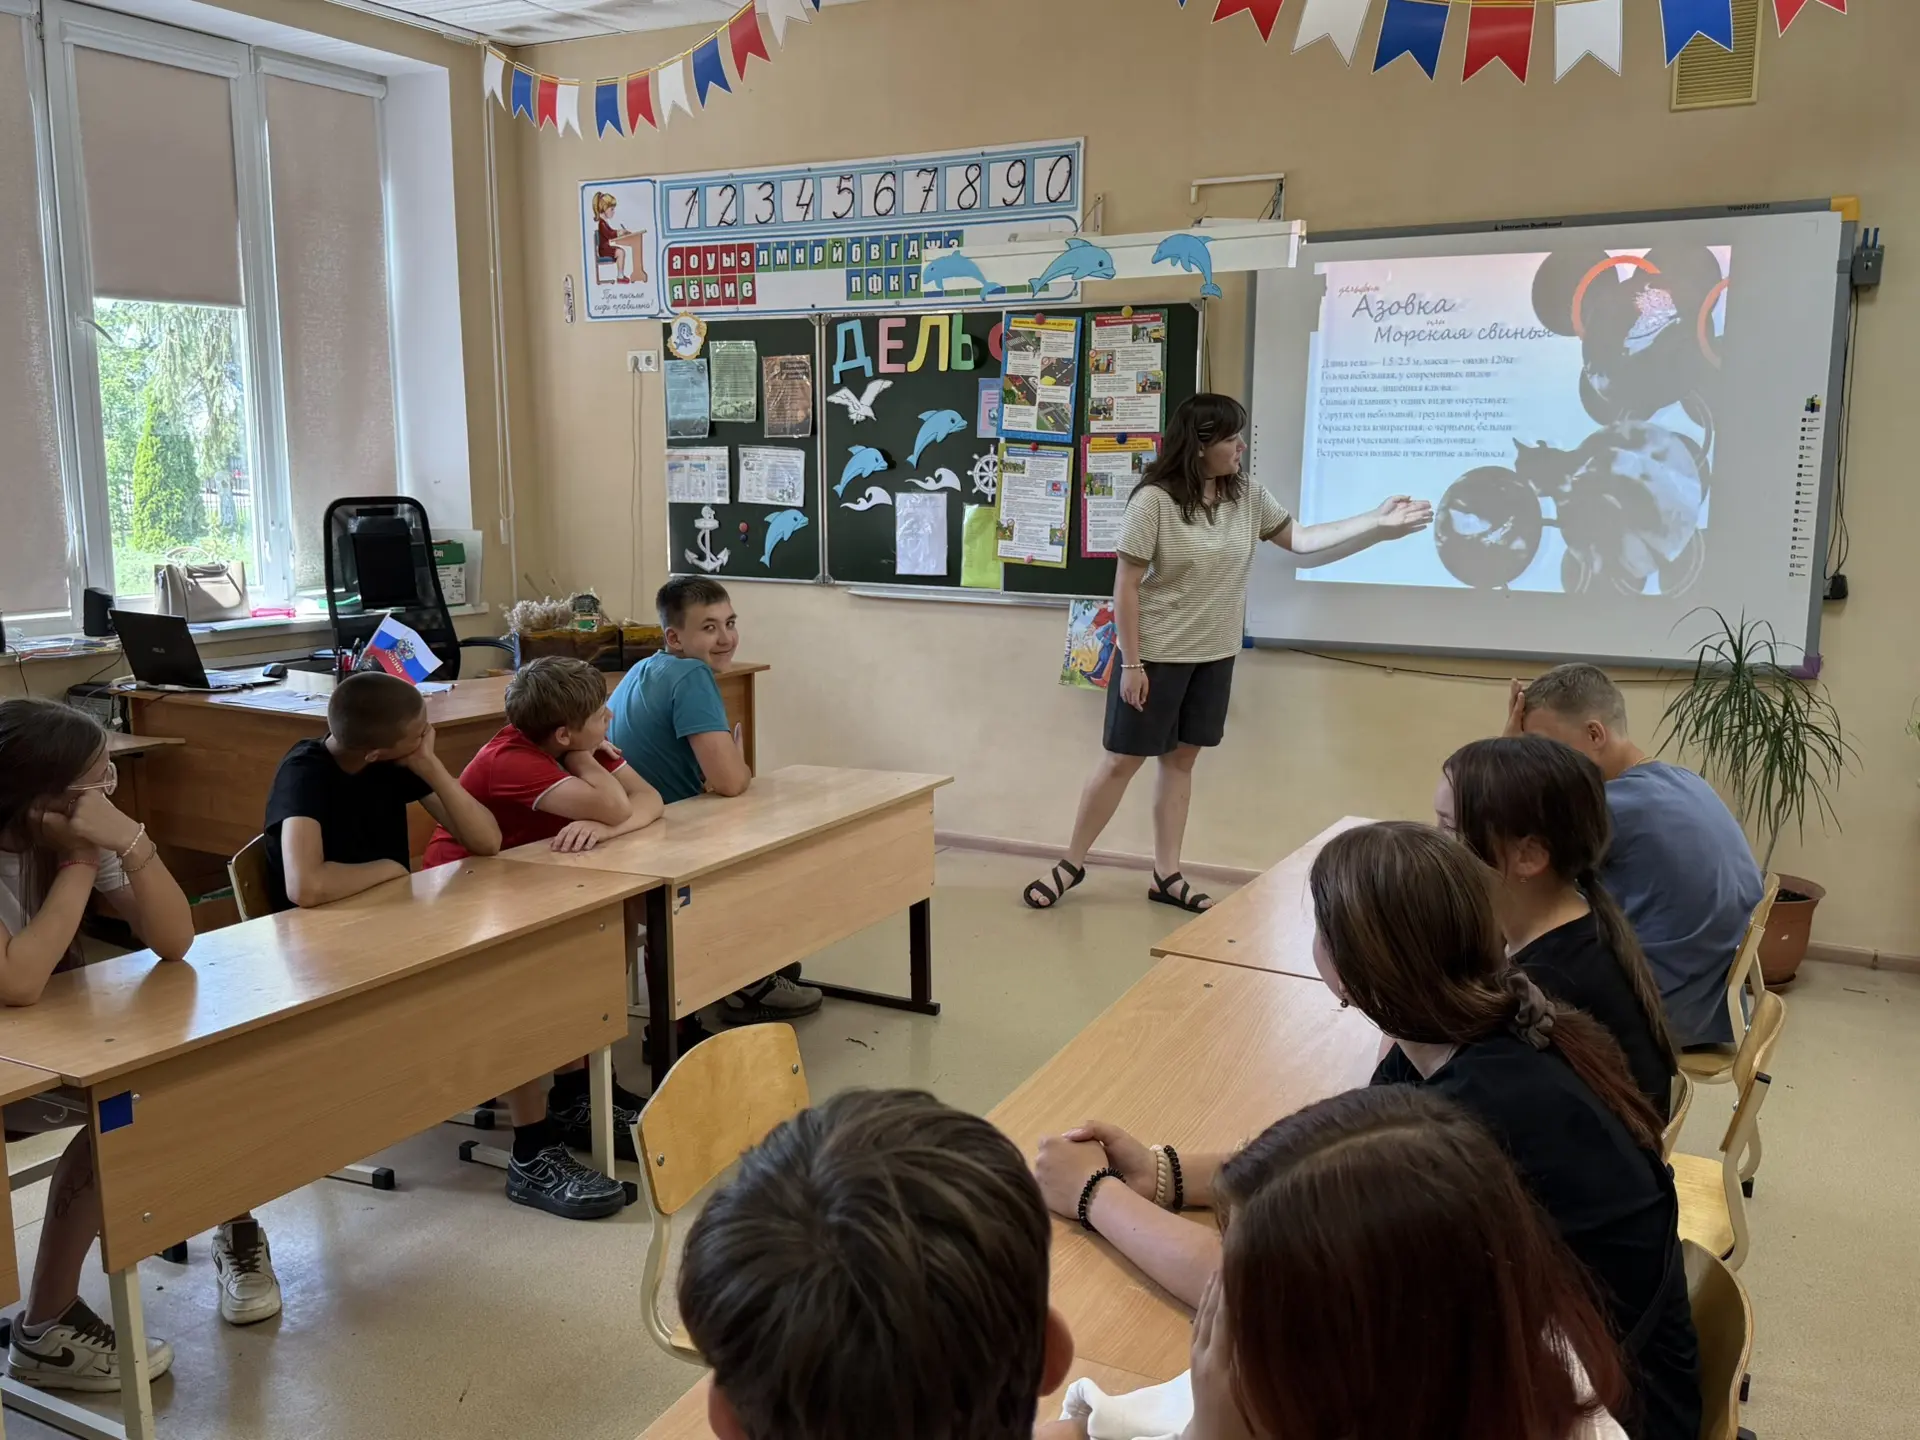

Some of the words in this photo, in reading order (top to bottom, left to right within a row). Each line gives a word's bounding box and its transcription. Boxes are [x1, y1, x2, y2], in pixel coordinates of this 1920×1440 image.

[684, 186, 699, 229] 1
[717, 184, 737, 227] 2
[755, 181, 775, 224] 3
[796, 178, 814, 222] 4
[832, 174, 855, 219] 5
[873, 171, 896, 216] 6
[916, 167, 938, 213] 7
[957, 163, 982, 210] 8
[1002, 159, 1026, 206] 9
[1046, 154, 1072, 203] 0
[1351, 292, 1456, 322] Азовка
[1373, 323, 1473, 347] Морская
[1476, 322, 1556, 341] свинья
[1405, 371, 1463, 381] современных
